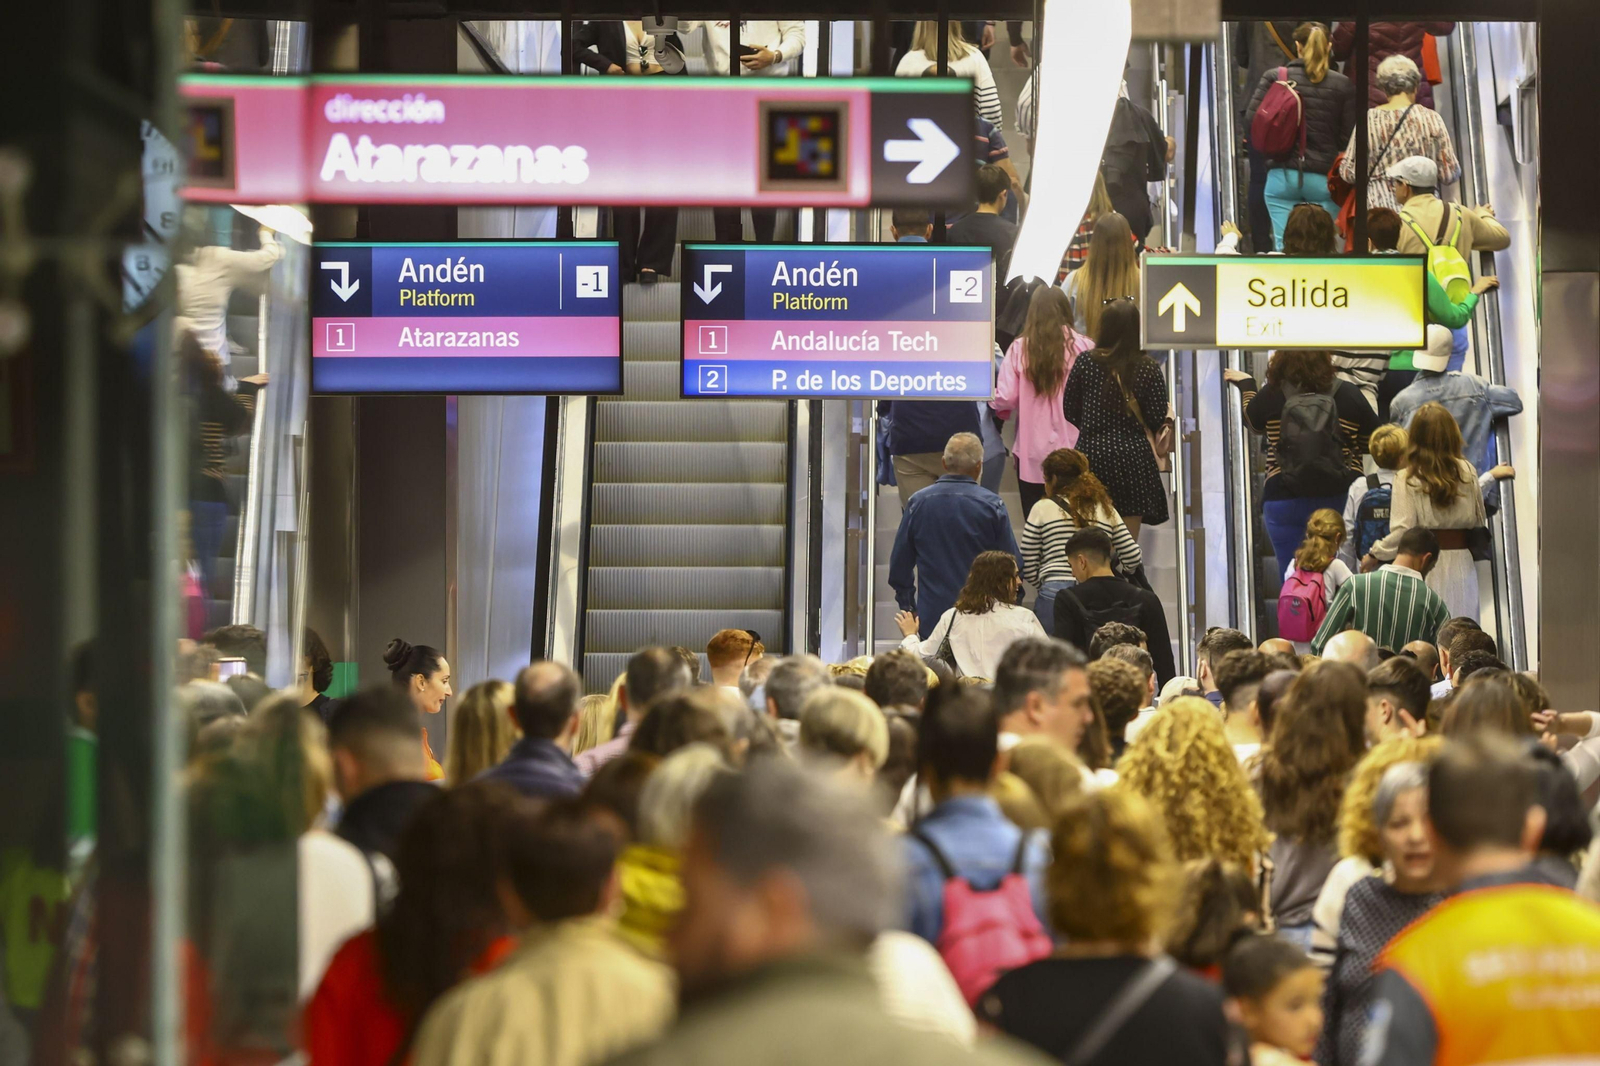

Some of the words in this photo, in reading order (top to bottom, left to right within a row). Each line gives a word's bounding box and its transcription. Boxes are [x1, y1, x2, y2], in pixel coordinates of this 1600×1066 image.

[324, 93, 446, 123] dirección
[320, 132, 590, 184] Atarazanas
[398, 256, 485, 283] Andén
[771, 260, 859, 287] Andén
[581, 271, 603, 292] -1
[955, 276, 979, 297] -2
[399, 289, 475, 306] Platform
[772, 292, 848, 310] Platform
[1247, 278, 1349, 308] Salida
[335, 328, 346, 346] 1
[398, 327, 520, 347] Atarazanas
[1246, 316, 1283, 337] Exit
[708, 331, 718, 349] 1
[771, 330, 880, 351] Andalucía
[888, 331, 939, 352] Tech
[706, 370, 719, 388] 2
[772, 370, 787, 390] P.
[796, 370, 823, 390] de
[831, 371, 861, 391] los
[870, 372, 967, 395] Deportes
